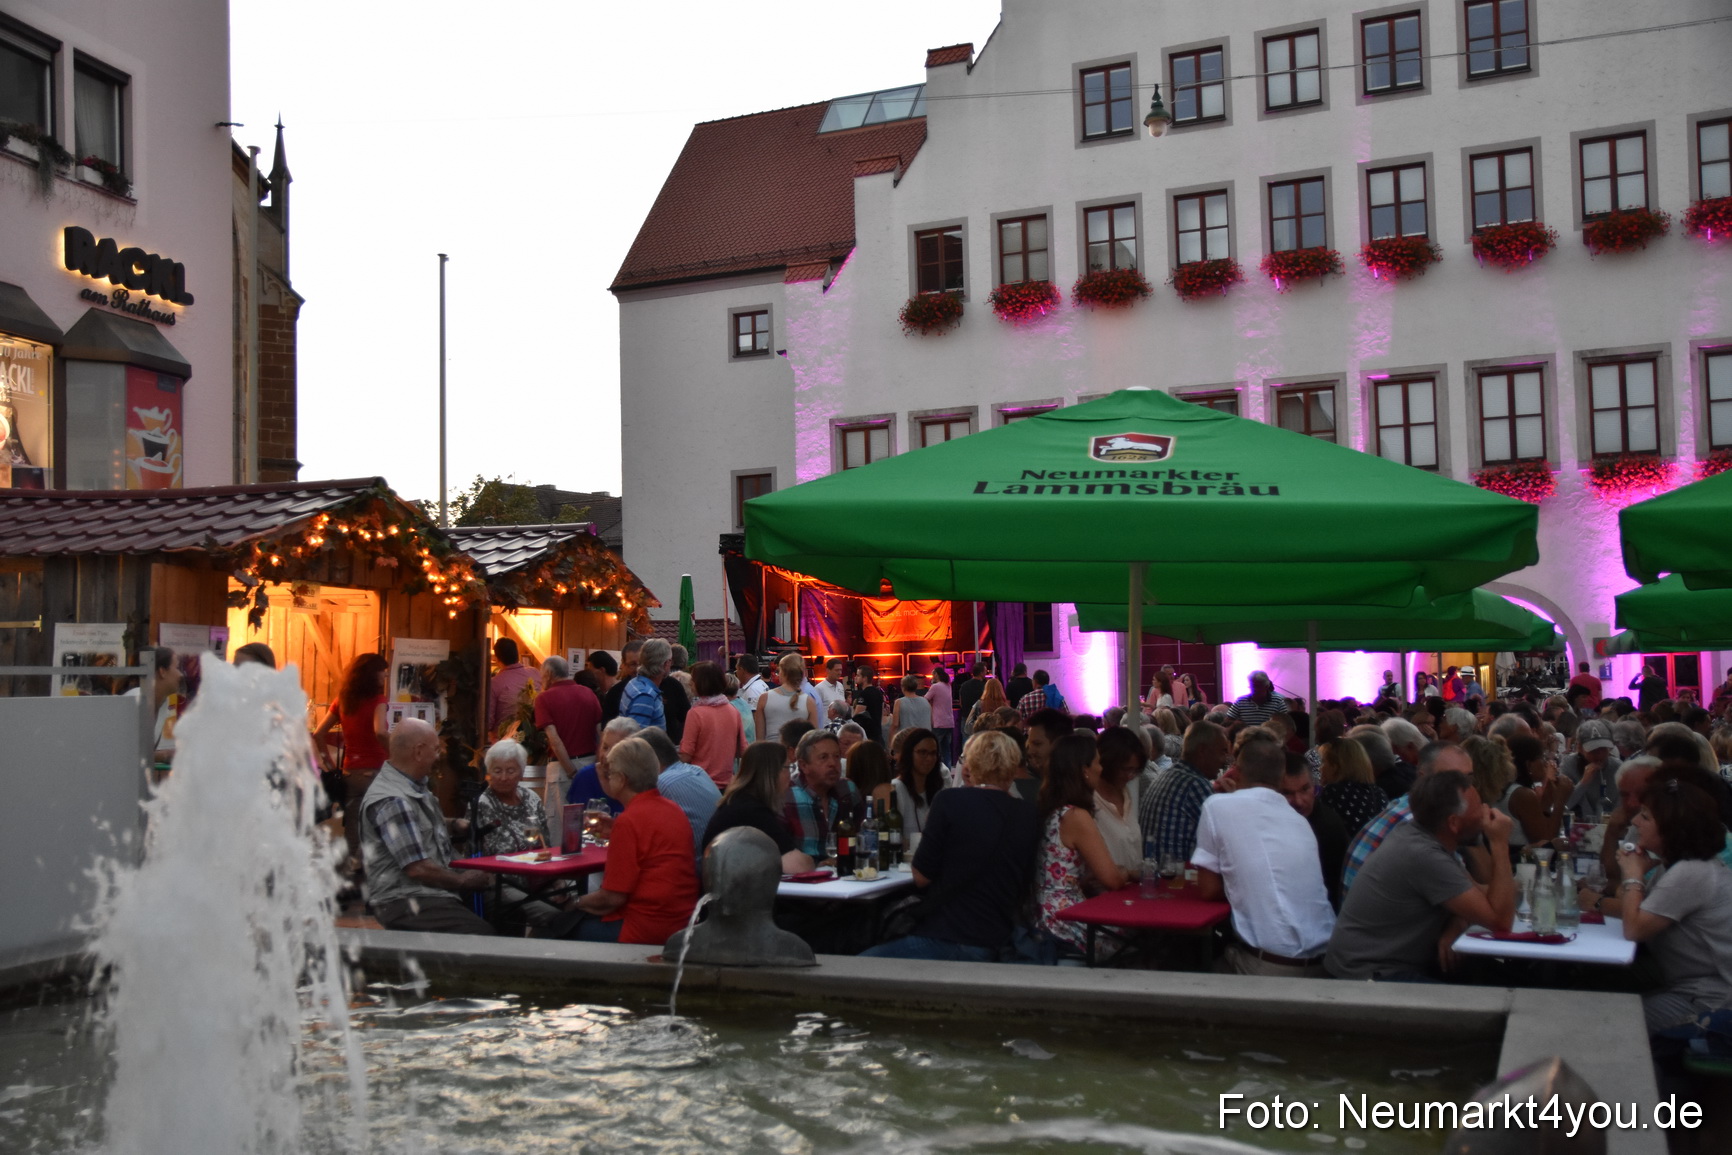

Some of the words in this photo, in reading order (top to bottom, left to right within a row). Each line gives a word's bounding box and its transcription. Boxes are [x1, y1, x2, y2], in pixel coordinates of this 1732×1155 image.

[64, 226, 194, 305] RACKL
[81, 287, 109, 305] am
[110, 288, 176, 325] Rathaus
[0, 361, 34, 395] ACKL
[1021, 469, 1240, 481] Neumarkter
[973, 481, 1280, 496] Lammsbräu
[1590, 726, 1602, 739] A
